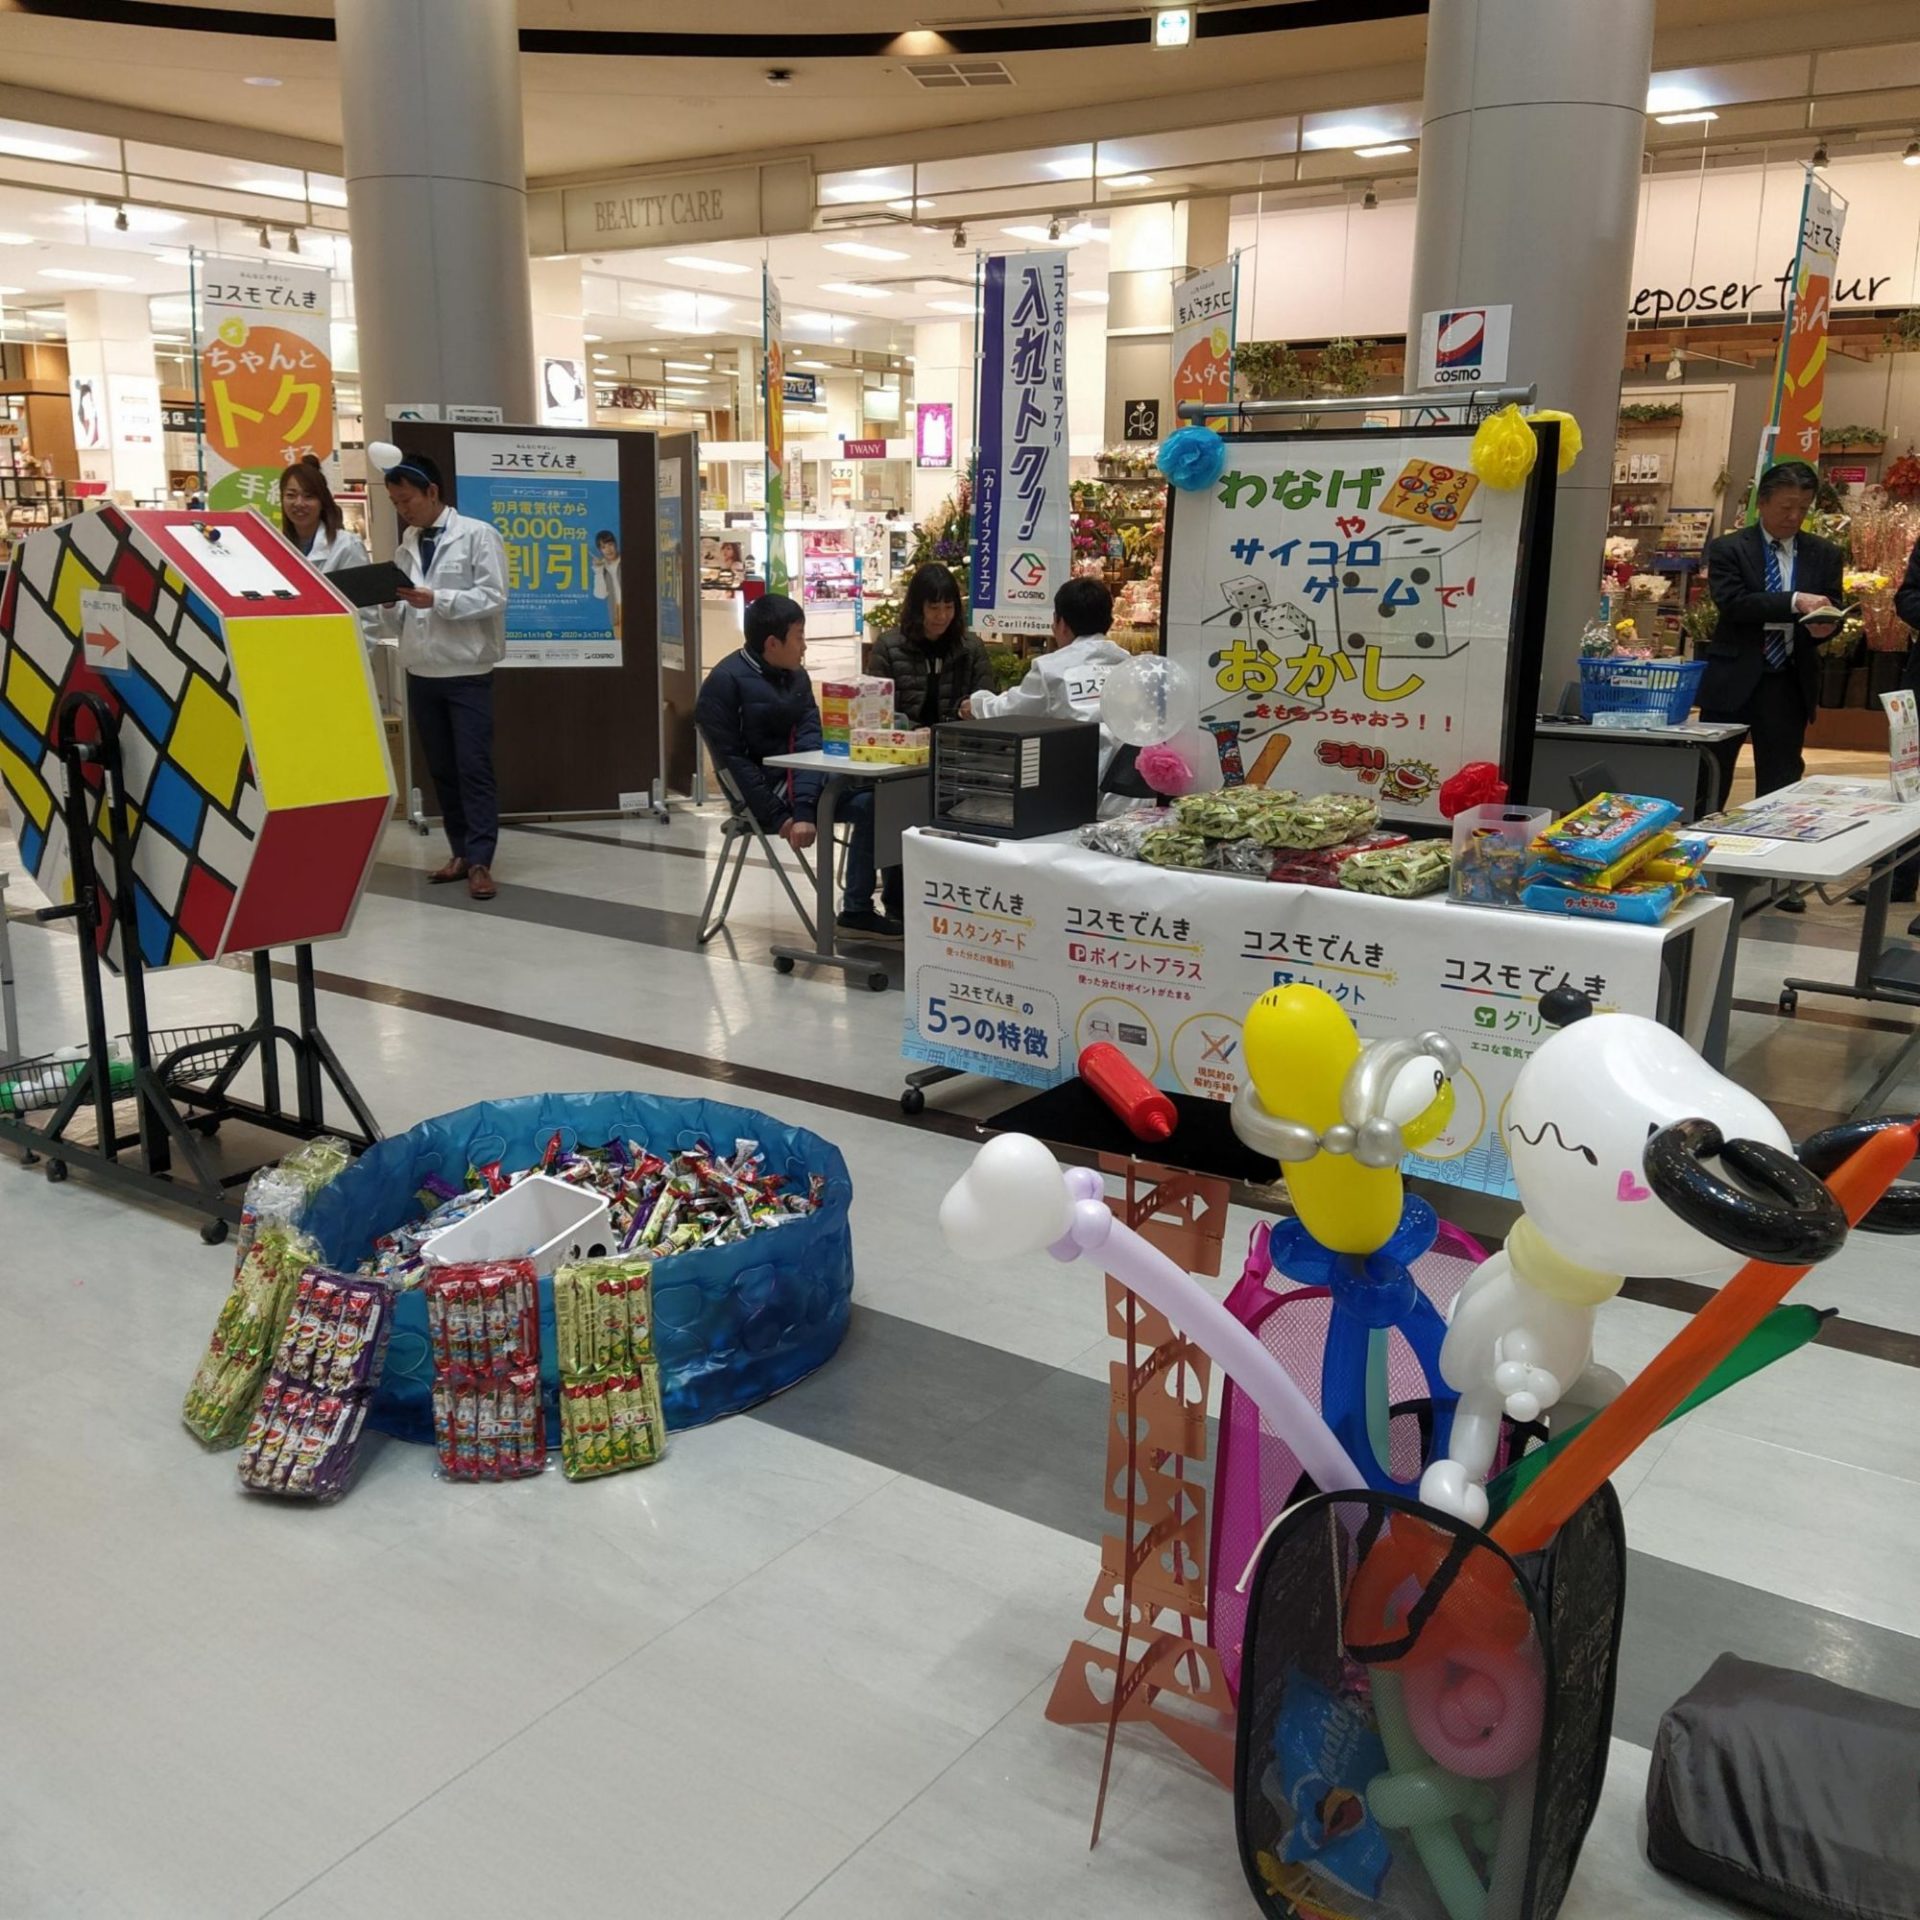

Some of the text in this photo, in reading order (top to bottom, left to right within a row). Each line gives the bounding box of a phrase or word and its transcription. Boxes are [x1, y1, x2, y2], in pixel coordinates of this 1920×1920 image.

[594, 188, 724, 233] BEAUTY CARE
[205, 283, 318, 309] コスモでんき
[1628, 282, 1763, 330] eposer
[205, 342, 318, 376] ちゃんと
[1434, 367, 1481, 383] COSMO
[211, 374, 321, 449] トク
[490, 452, 577, 469] コスモでんき
[849, 444, 880, 454] TWANY
[1216, 466, 1385, 510] わなげ
[491, 500, 588, 517] 初月電気代から
[1335, 515, 1367, 539] や
[1229, 538, 1382, 567] サイコロ
[1214, 638, 1425, 703] おかし
[925, 881, 1024, 916] コスモでんき
[952, 920, 1026, 951] スタンダード
[1067, 907, 1191, 942] コスモでんき
[1090, 947, 1203, 981] ポイントプラス
[1244, 930, 1385, 969] コスモでんき
[1078, 974, 1192, 1001] 使った分だけポイントがたまる
[926, 996, 1049, 1060] 5つの特徴
